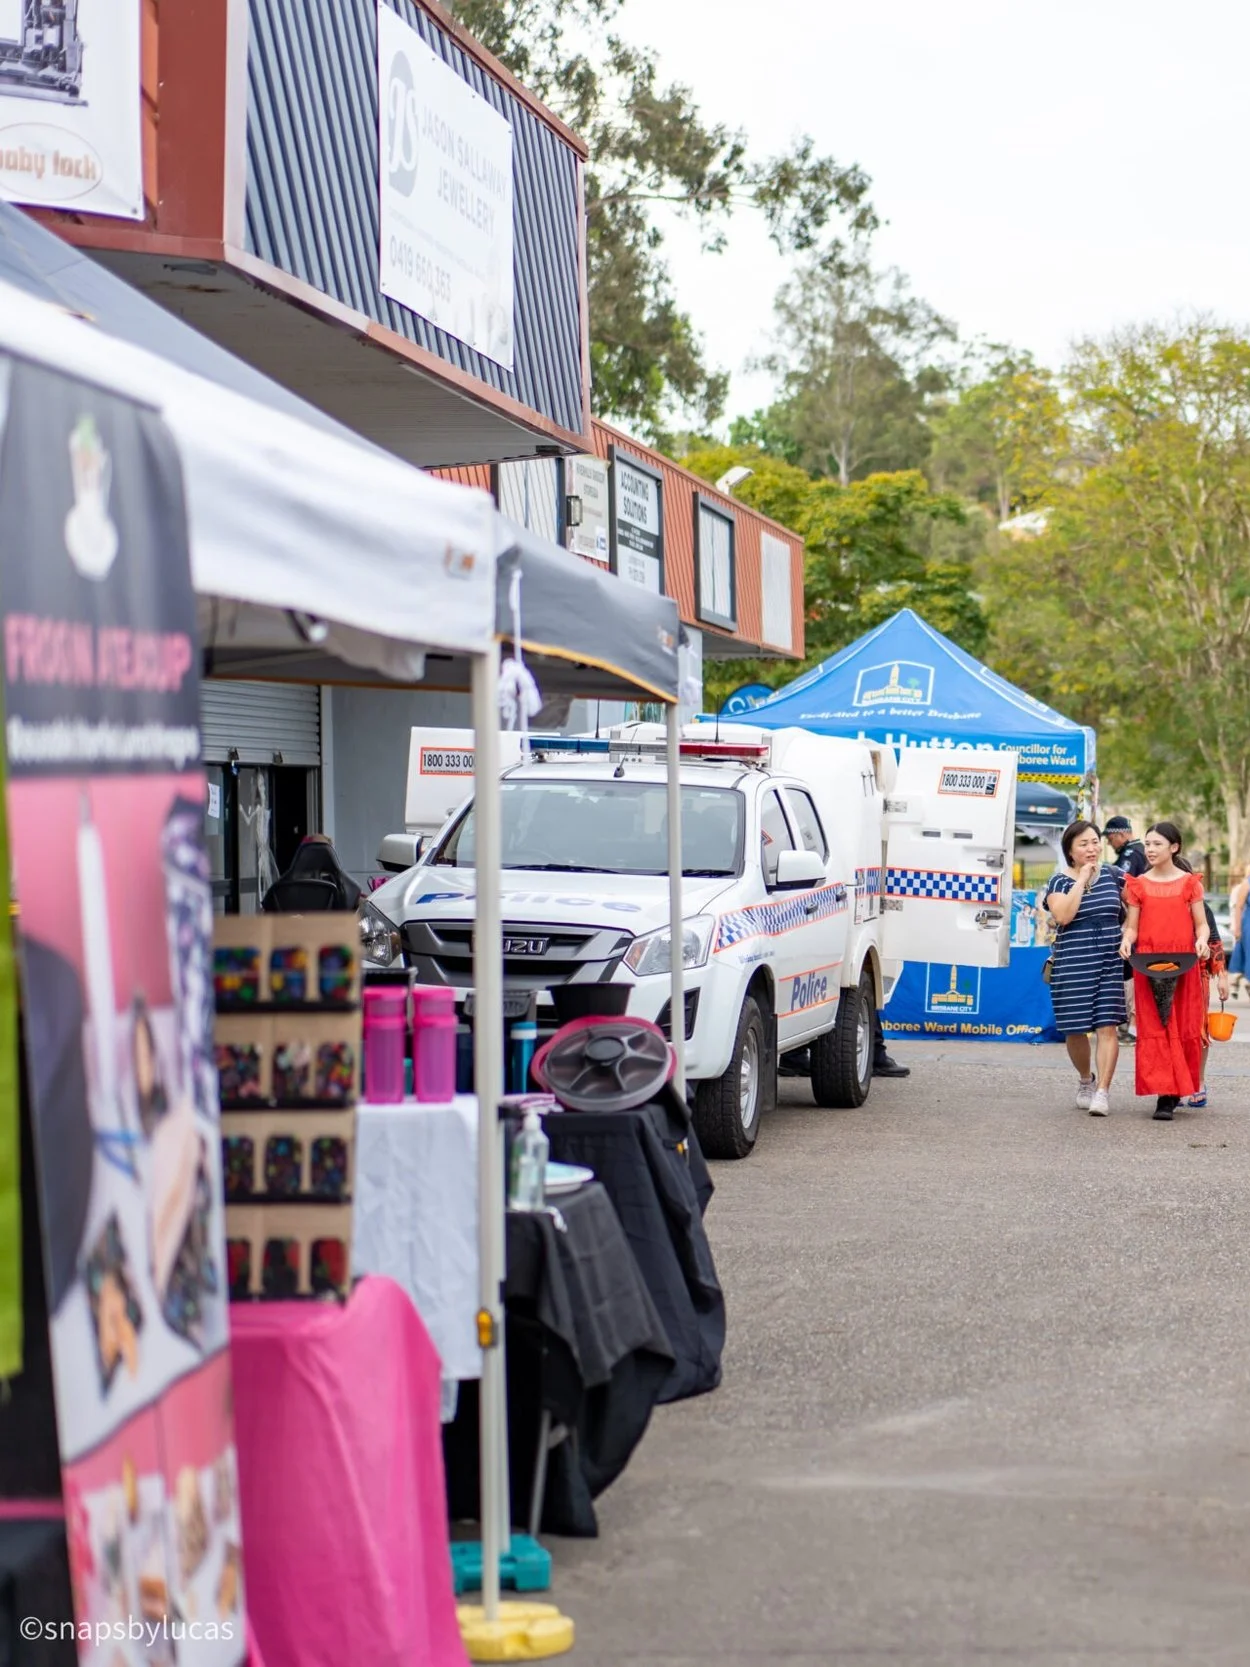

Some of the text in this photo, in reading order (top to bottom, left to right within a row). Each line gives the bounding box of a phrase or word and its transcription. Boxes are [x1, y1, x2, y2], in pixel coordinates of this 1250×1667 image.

[437, 167, 495, 238] JEWELLERY
[621, 470, 649, 502] ACCOUNTING
[623, 496, 648, 525] SOLUTIONS
[863, 709, 875, 718] to
[889, 706, 924, 717] better
[927, 708, 982, 720] Brisbane
[999, 743, 1068, 755] Councillor for
[423, 754, 444, 767] 1800
[445, 754, 461, 768] 333
[1018, 754, 1077, 766] boree Ward
[942, 773, 986, 789] 1800 333 000
[790, 971, 828, 1012] Police
[924, 1022, 957, 1033] Ward
[960, 1023, 1002, 1036] Mobile
[1006, 1024, 1043, 1036] Office
